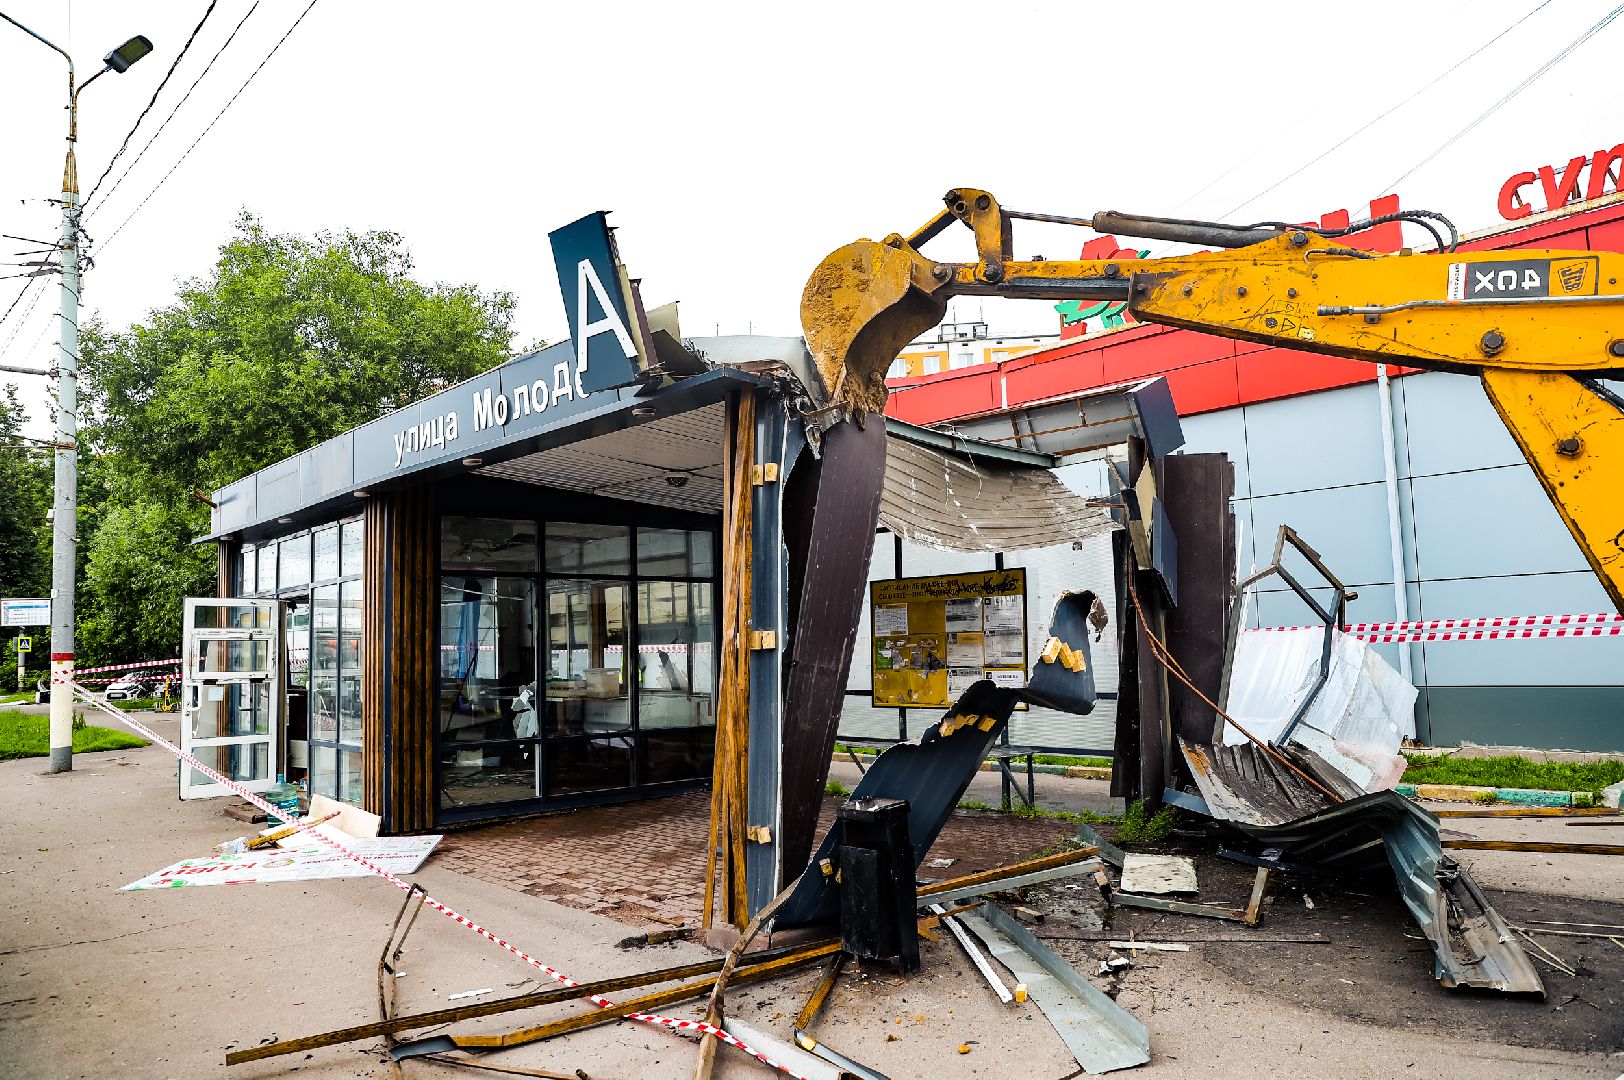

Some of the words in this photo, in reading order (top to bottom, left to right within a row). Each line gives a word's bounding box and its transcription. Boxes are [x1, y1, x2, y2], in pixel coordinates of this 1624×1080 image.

[1474, 269, 1541, 294] 4CX
[1561, 267, 1585, 291] JCB
[577, 258, 639, 373] А
[394, 411, 458, 468] улица
